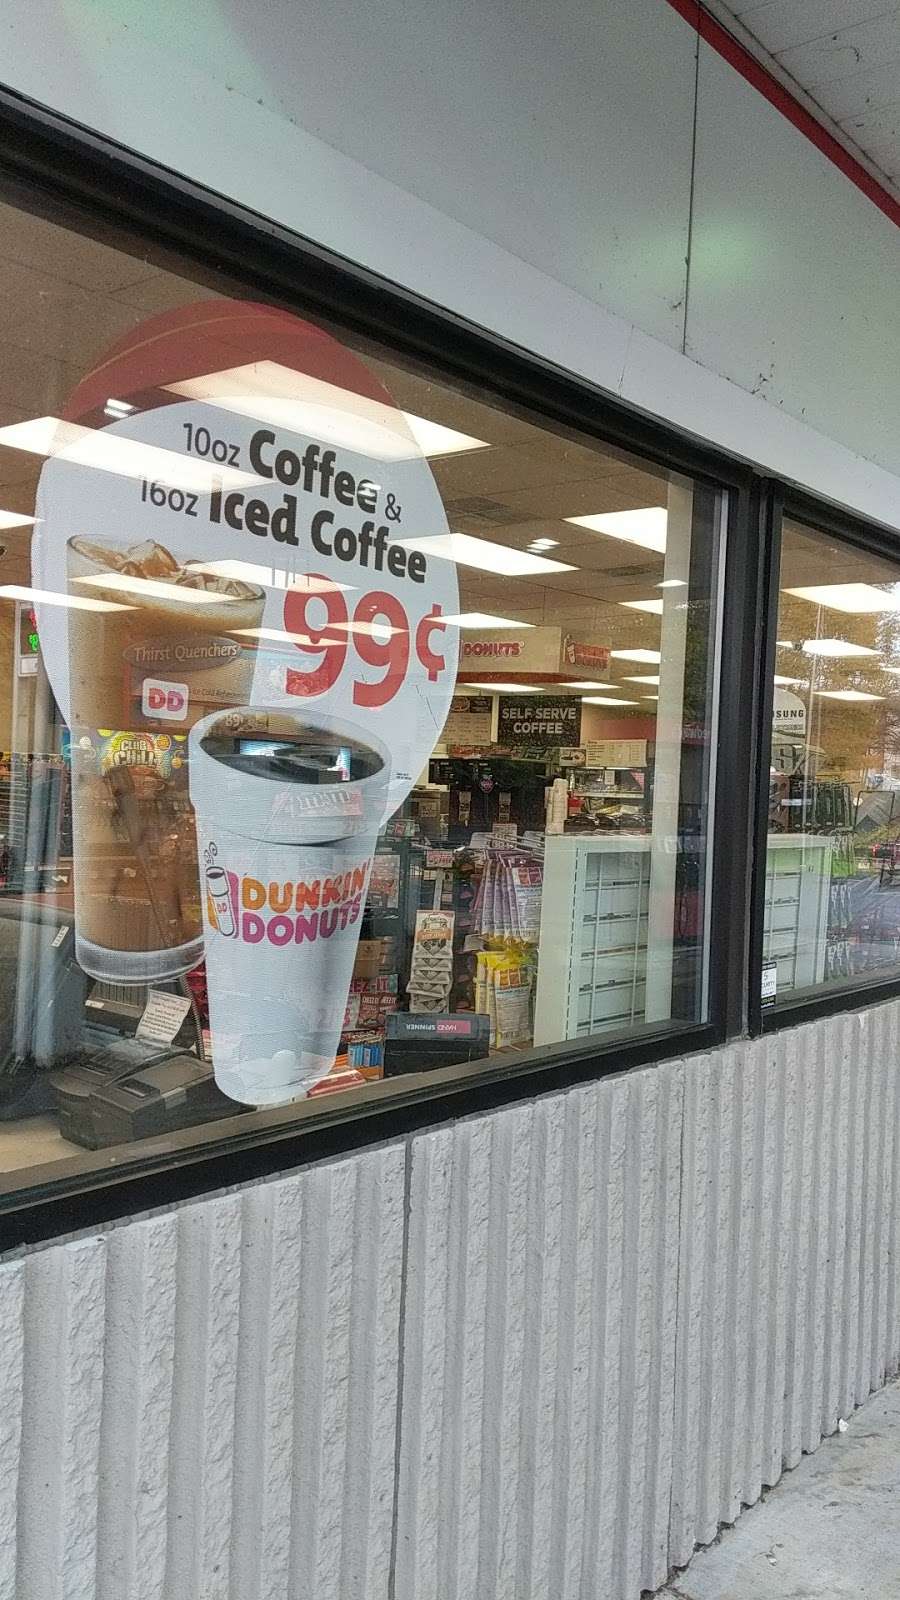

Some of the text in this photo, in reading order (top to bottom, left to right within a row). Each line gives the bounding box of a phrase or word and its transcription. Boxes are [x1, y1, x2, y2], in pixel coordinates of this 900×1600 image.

[183, 422, 402, 523] 10oz Coffee &
[140, 472, 427, 583] 16oz Iced Coffee
[134, 642, 239, 662] Thirst Quenchers
[148, 687, 185, 712] DD
[502, 707, 577, 720] SELF SERVE
[513, 721, 564, 734] COFFEE
[241, 888, 365, 947] DONUTS
[406, 1023, 436, 1031] SPINNER
